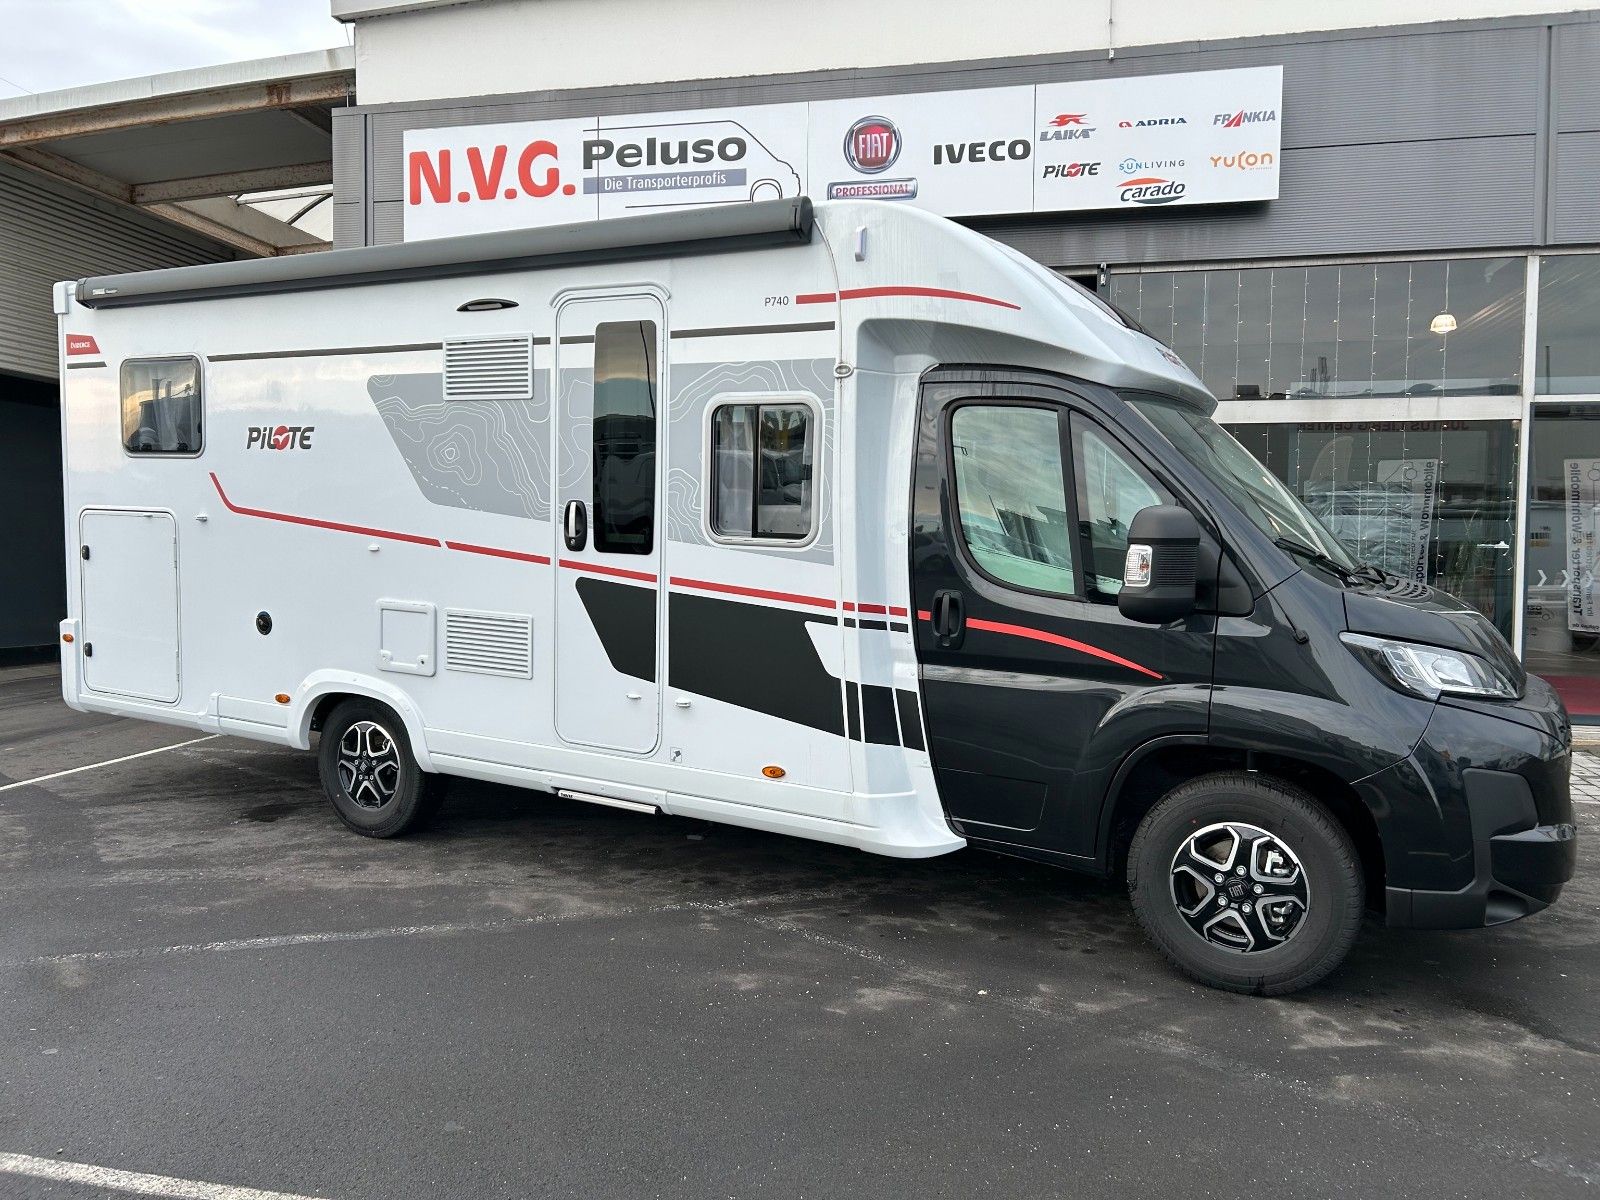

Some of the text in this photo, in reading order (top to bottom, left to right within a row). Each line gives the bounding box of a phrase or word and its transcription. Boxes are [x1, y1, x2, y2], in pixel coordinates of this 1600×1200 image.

[1135, 117, 1188, 127] ADRIA
[1213, 110, 1276, 128] FRANKIA
[1039, 128, 1097, 142] LAIKA
[582, 136, 748, 170] Peluso
[858, 133, 890, 159] FIAT
[933, 139, 1031, 165] IVECO
[409, 139, 576, 206] N.V.G.
[1118, 159, 1186, 173] SUNLIVING
[603, 172, 727, 191] Die Transporterprofis
[835, 184, 910, 197] PROFESSIONAL
[764, 295, 790, 307] P740
